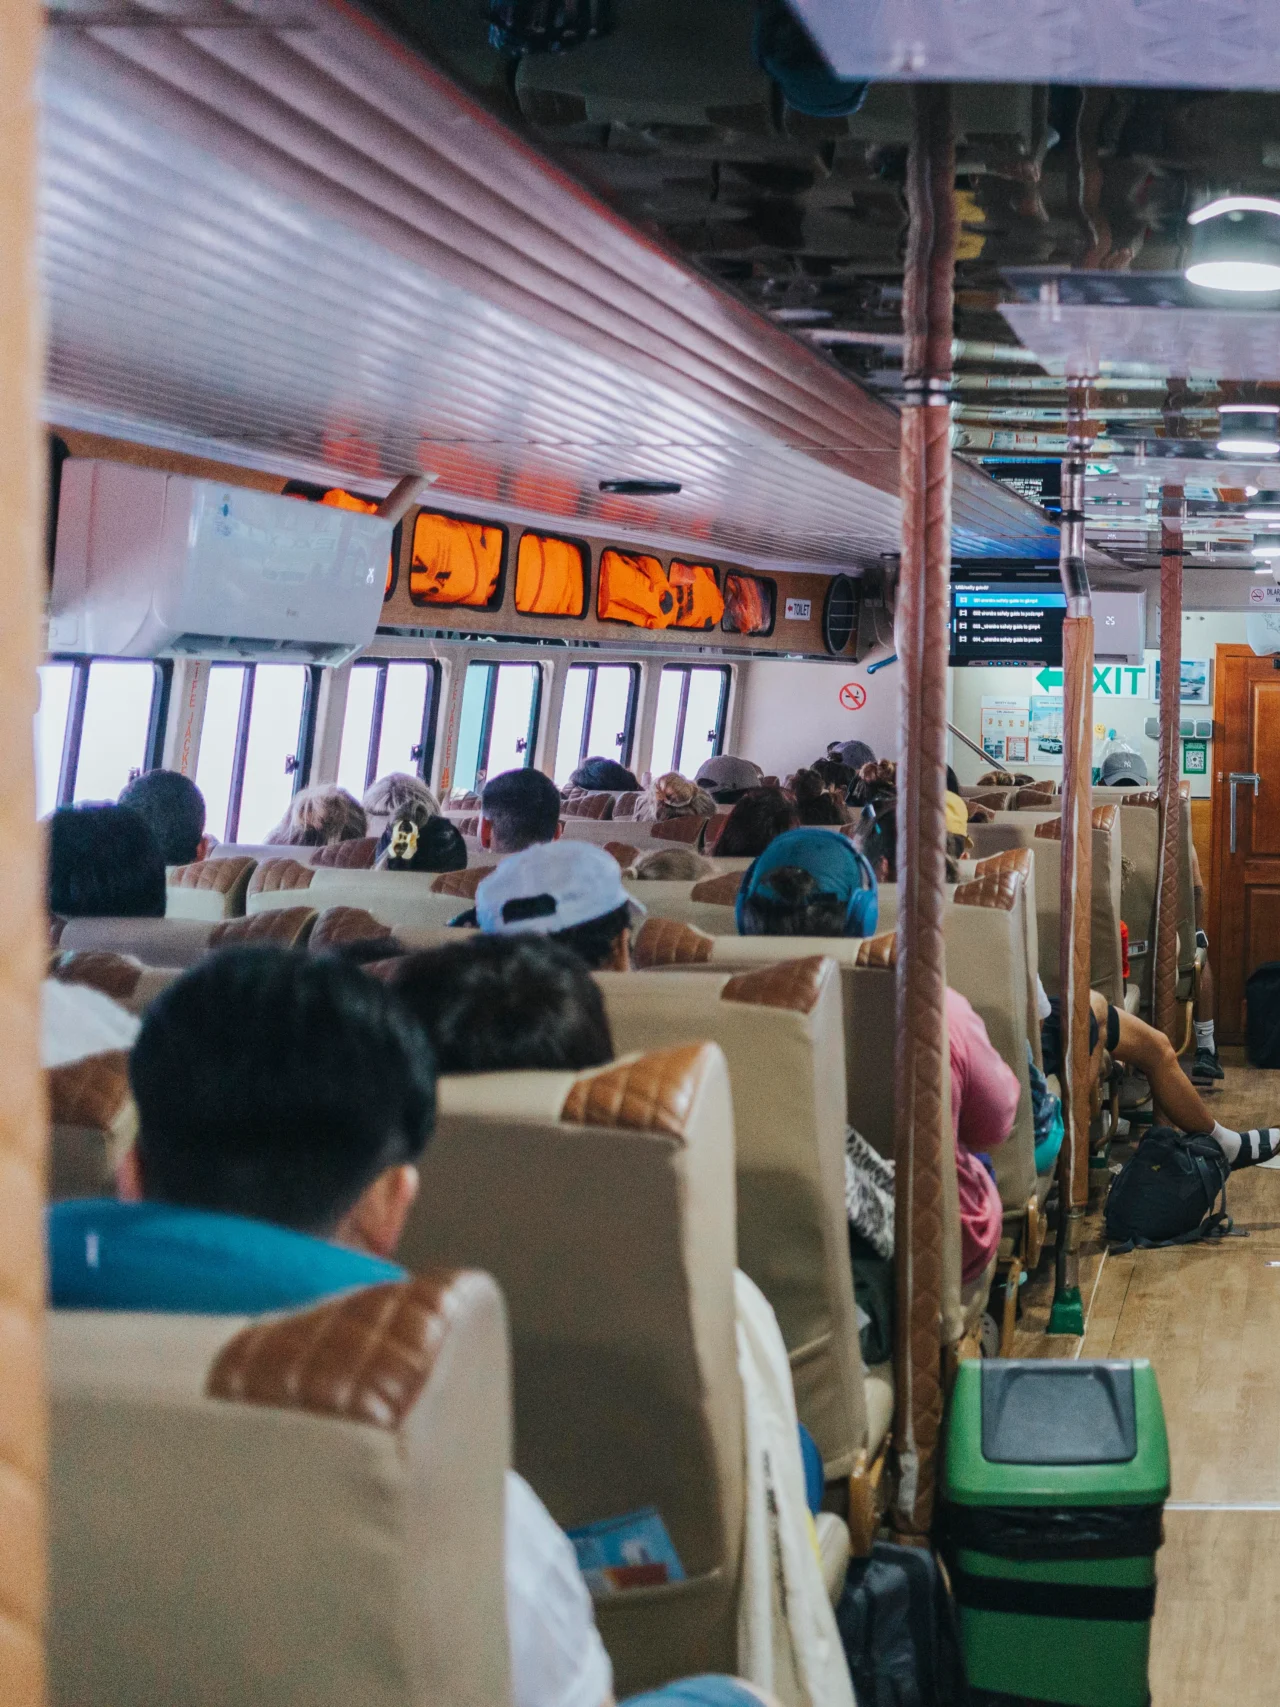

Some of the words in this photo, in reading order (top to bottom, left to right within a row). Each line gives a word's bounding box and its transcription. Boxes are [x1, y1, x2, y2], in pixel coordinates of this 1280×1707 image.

[794, 603, 810, 616] TOILET
[1092, 666, 1146, 695] XIT
[181, 711, 194, 776] JACKE
